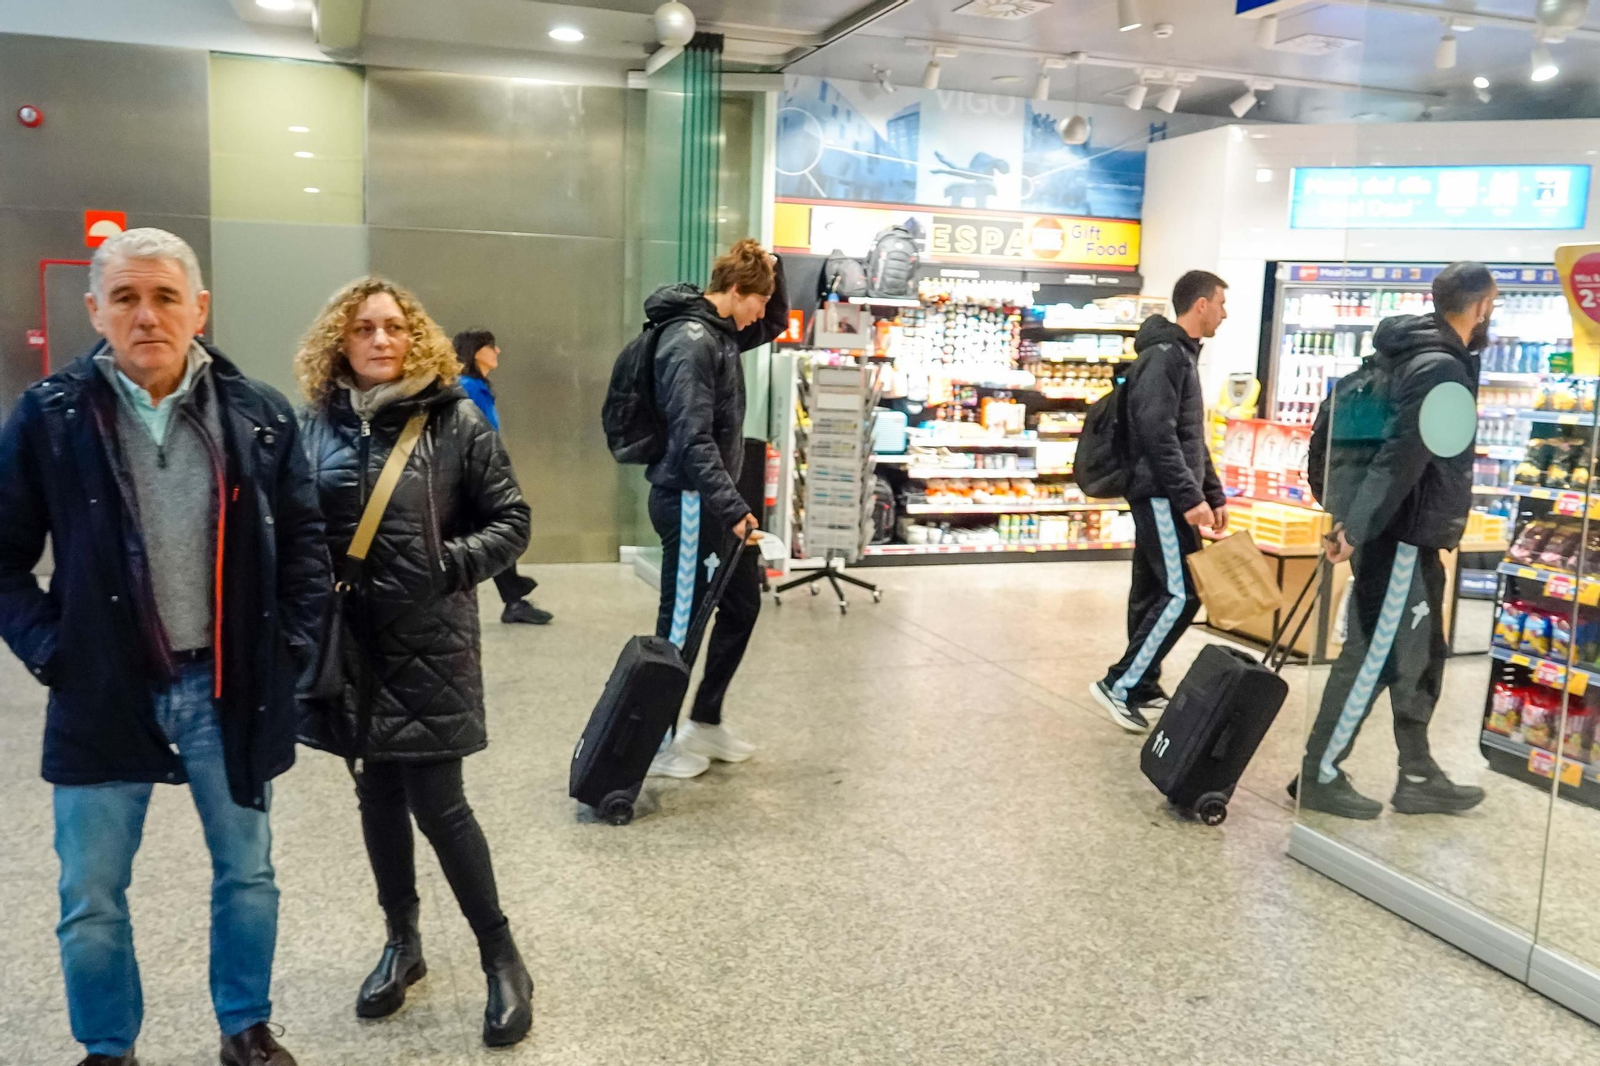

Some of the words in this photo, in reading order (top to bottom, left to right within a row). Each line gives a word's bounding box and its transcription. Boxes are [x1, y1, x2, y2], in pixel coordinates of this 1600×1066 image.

[935, 89, 1016, 115] VIGO
[1071, 224, 1102, 241] Gift
[1086, 242, 1128, 257] Food
